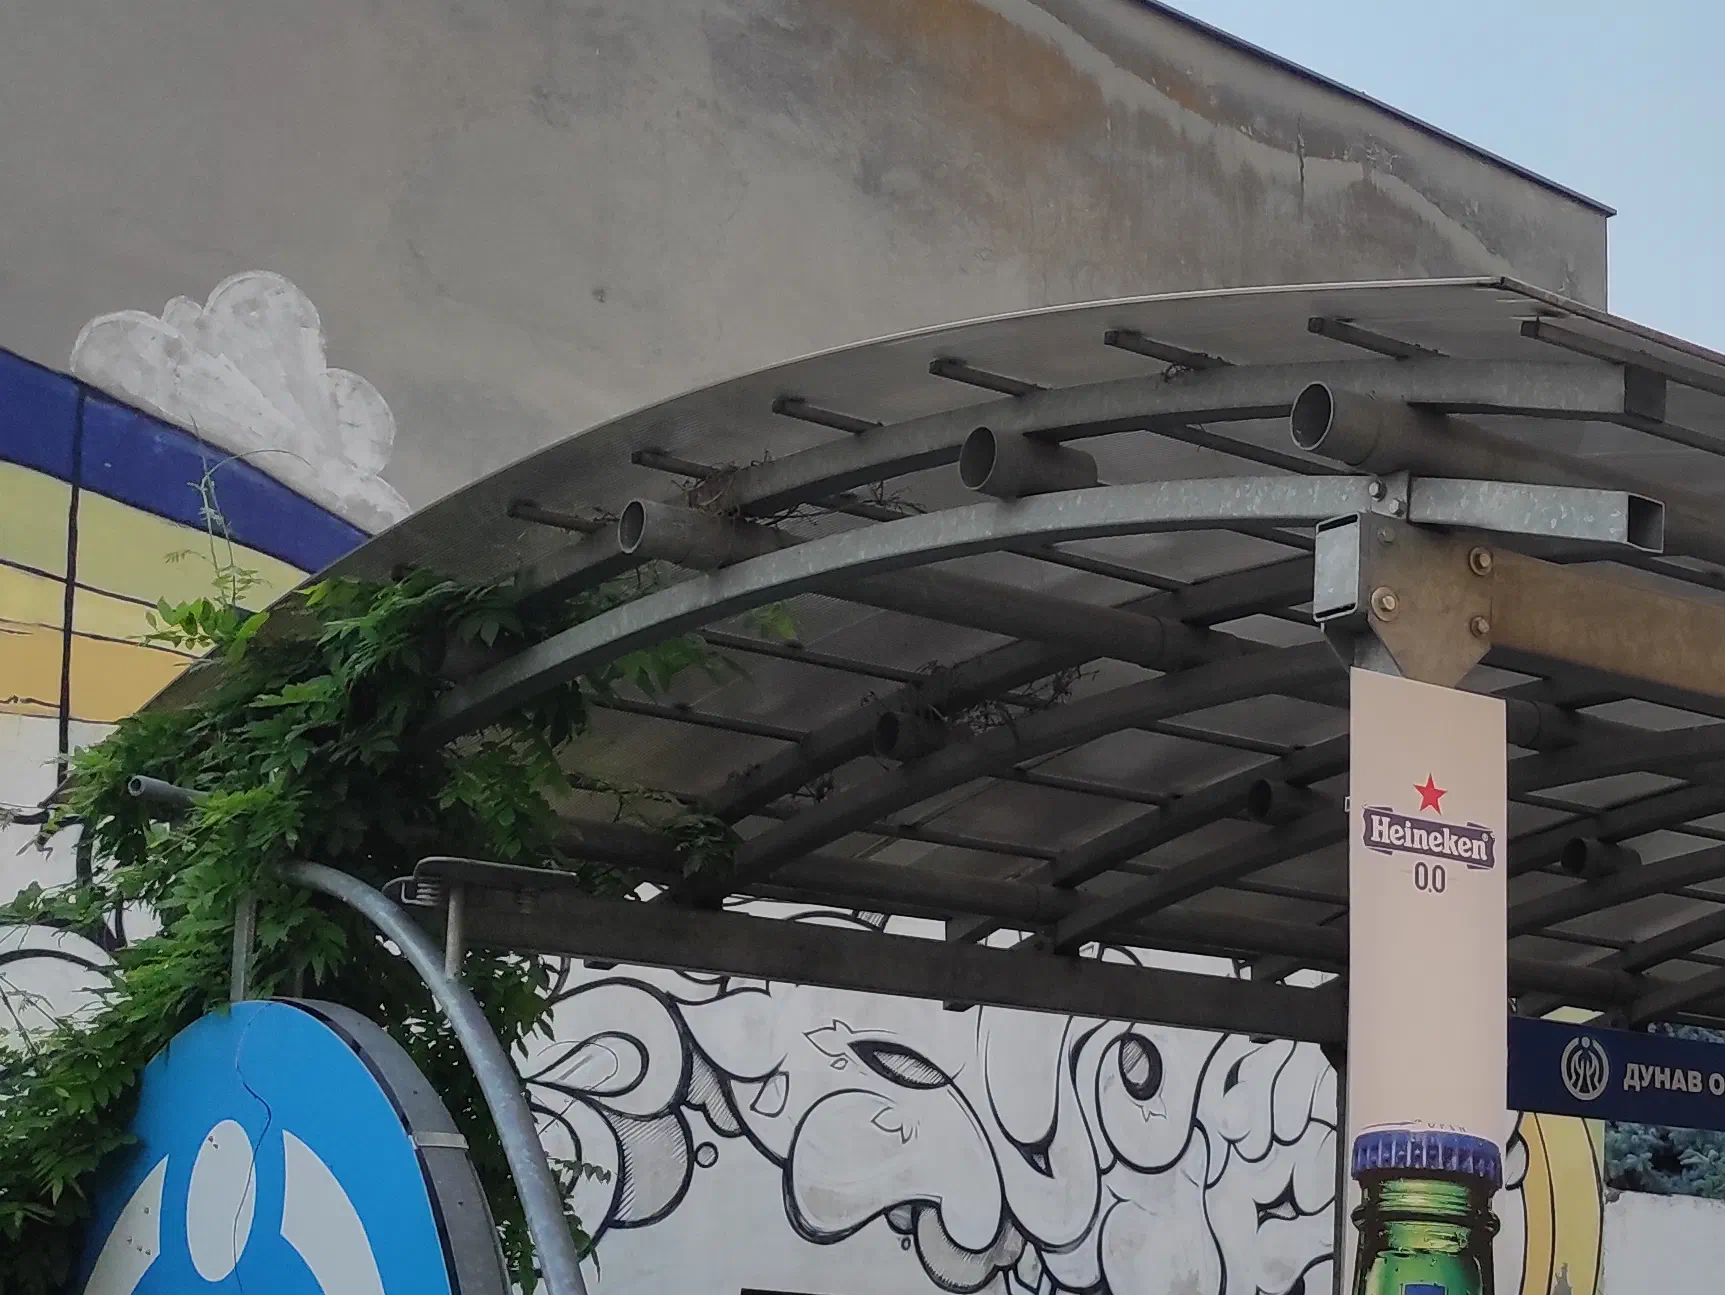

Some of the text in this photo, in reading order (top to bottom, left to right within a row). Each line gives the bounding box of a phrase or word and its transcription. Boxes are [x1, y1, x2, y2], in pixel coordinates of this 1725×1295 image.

[1370, 814, 1488, 861] Heineken
[1413, 861, 1446, 893] 0.0
[1623, 1063, 1702, 1093] ДУНАВ
